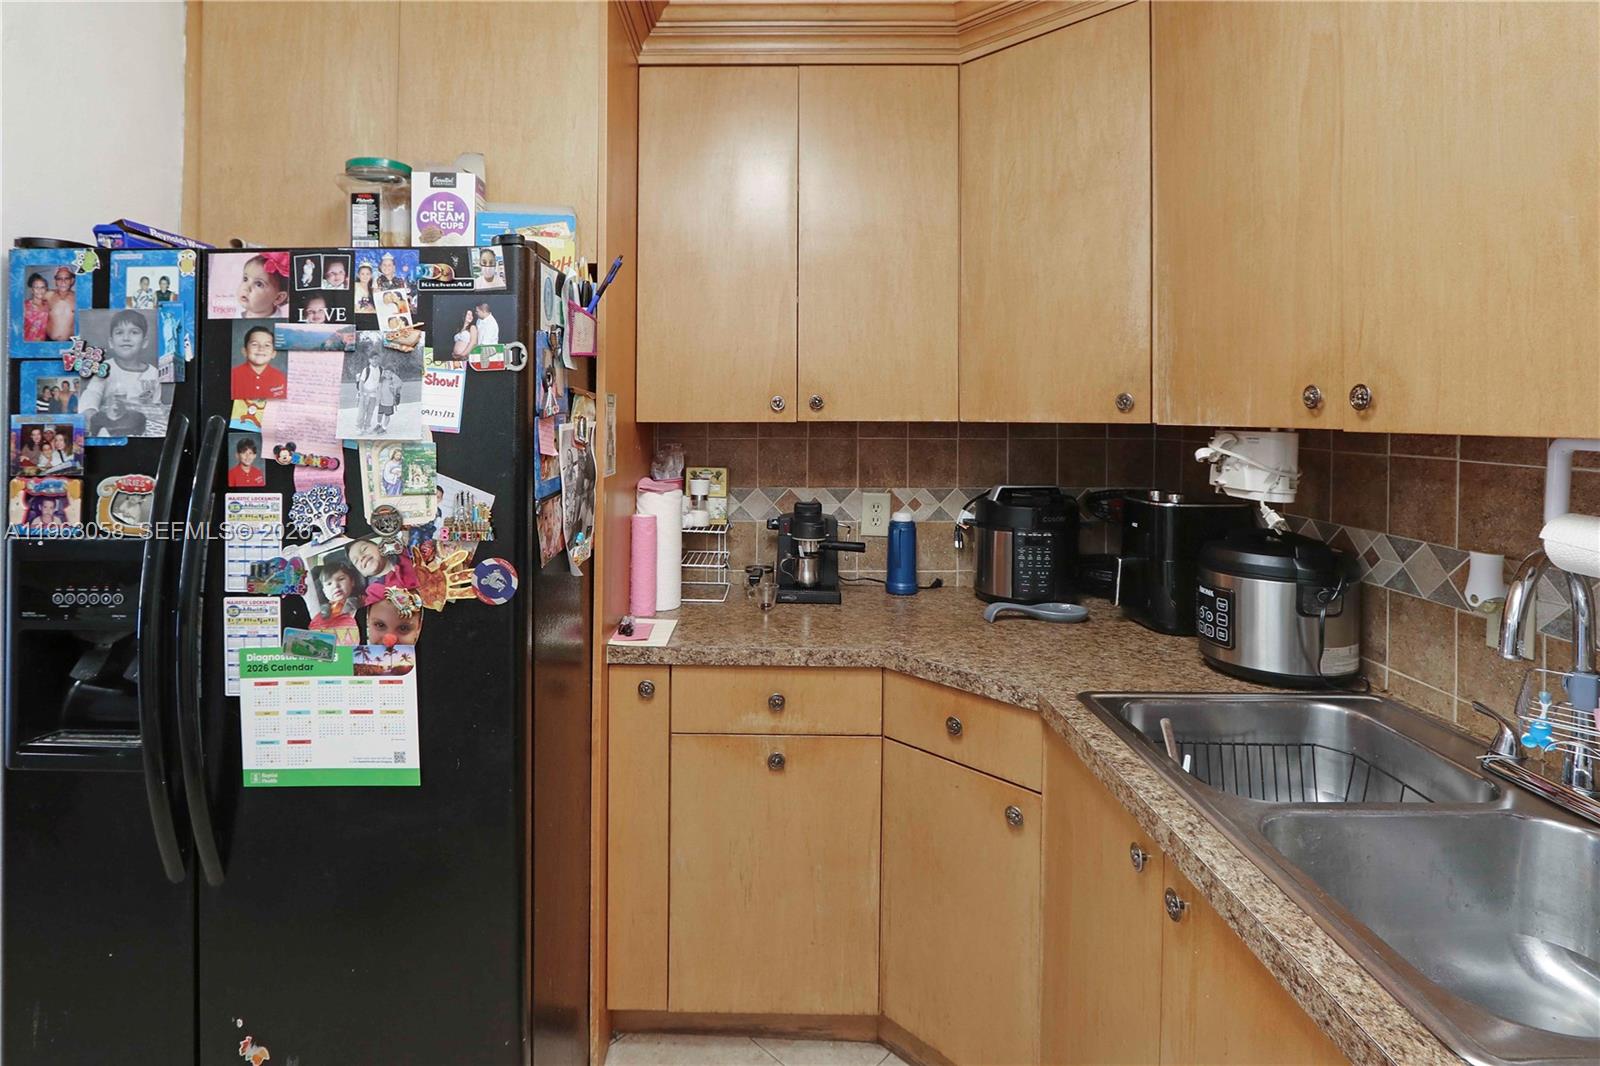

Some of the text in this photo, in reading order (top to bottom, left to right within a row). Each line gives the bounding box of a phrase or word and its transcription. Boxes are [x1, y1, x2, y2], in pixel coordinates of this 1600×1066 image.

[433, 200, 455, 212] ICE
[420, 210, 465, 225] CREAM
[440, 222, 464, 230] CUPS
[297, 307, 347, 322] LVE
[424, 372, 460, 388] Show!
[247, 663, 314, 673] 2026 Calendar
